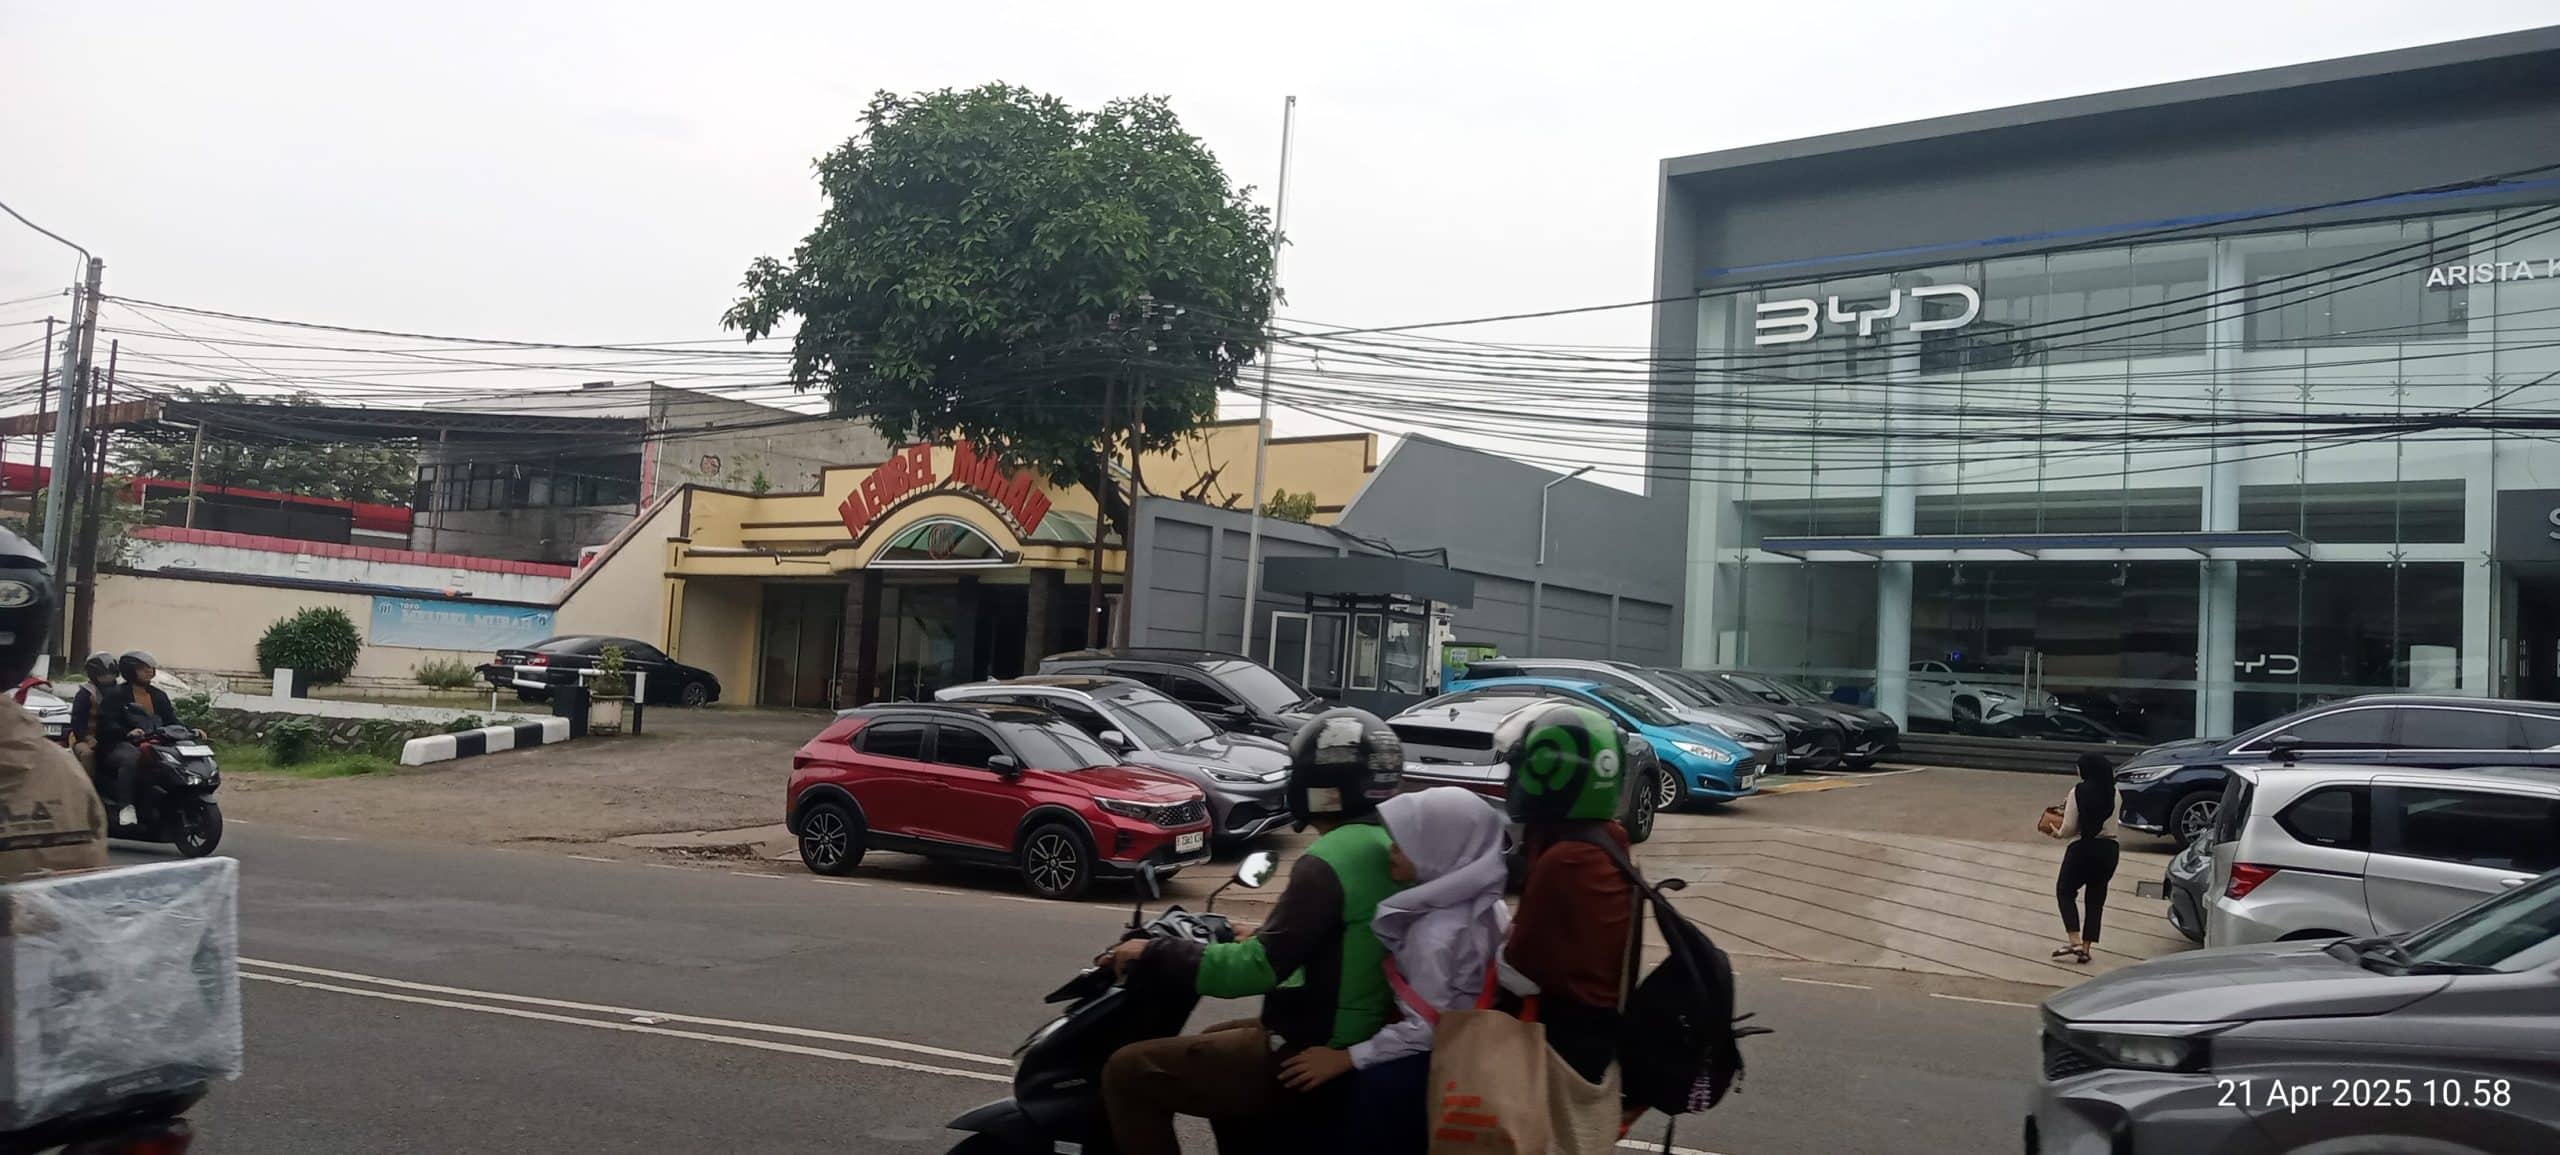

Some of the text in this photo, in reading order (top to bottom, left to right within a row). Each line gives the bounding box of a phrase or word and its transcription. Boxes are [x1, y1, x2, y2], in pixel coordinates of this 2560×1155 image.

[2426, 260, 2534, 288] ARISTA
[1755, 284, 1980, 345] BYD
[838, 443, 936, 540] MEUBEL
